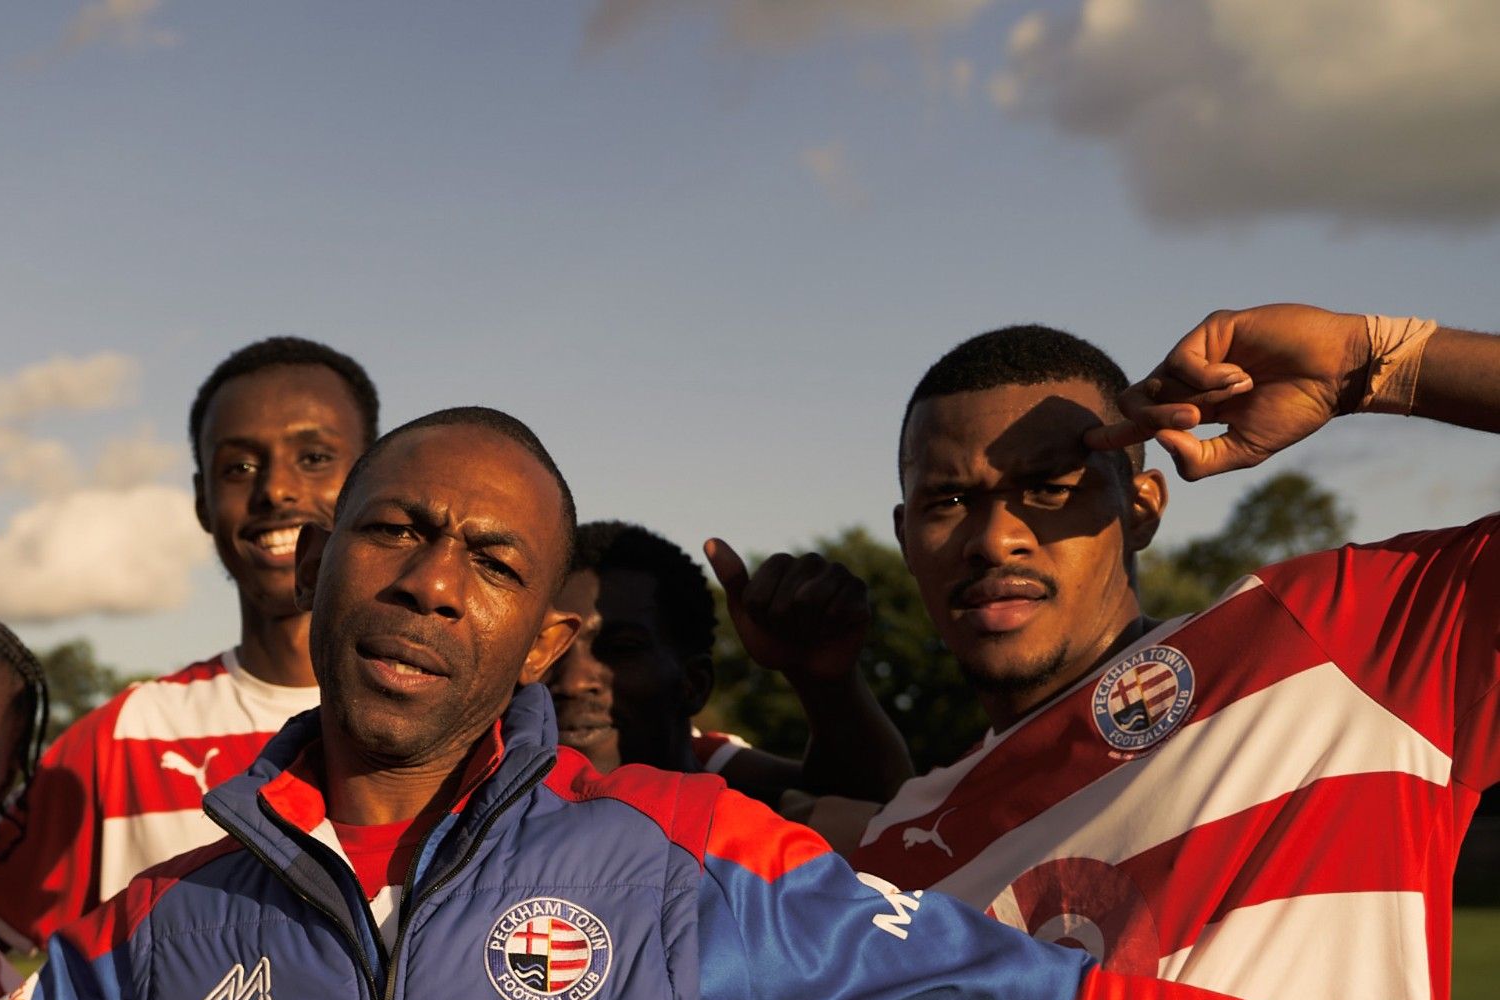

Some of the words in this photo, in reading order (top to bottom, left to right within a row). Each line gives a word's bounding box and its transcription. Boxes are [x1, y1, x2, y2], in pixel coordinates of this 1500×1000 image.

[1096, 652, 1145, 715] PECKHAM
[1150, 649, 1187, 673] TOWN
[1109, 723, 1168, 746] FOOTBALL
[1166, 689, 1190, 725] CLUB
[490, 901, 561, 951] PECKHAM
[568, 907, 608, 951] TOWN
